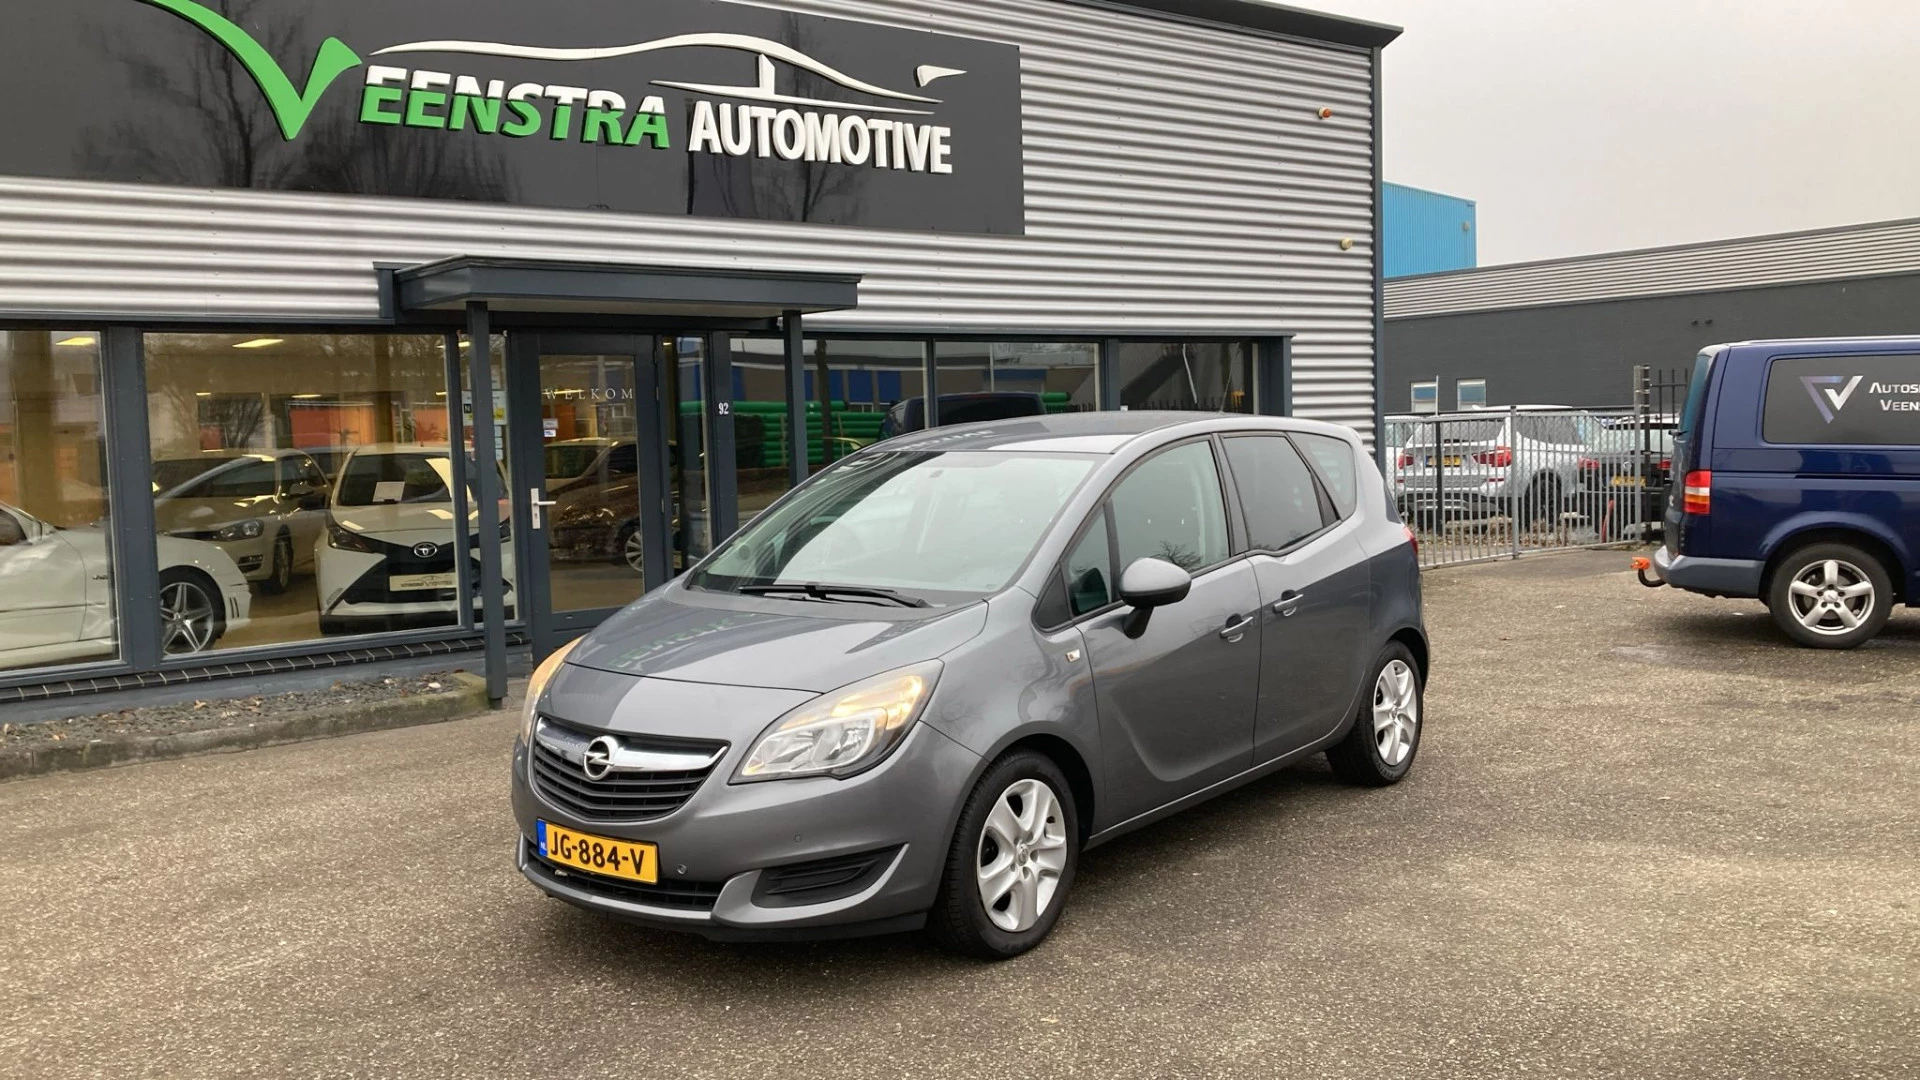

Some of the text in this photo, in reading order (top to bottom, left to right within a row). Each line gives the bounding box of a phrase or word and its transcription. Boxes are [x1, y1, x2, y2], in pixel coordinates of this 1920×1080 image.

[688, 100, 952, 174] AUTOMOTIVE
[544, 387, 633, 400] WELKOM
[718, 402, 729, 415] 92
[1880, 399, 1920, 412] VEEN
[550, 831, 645, 875] JG-884-V
